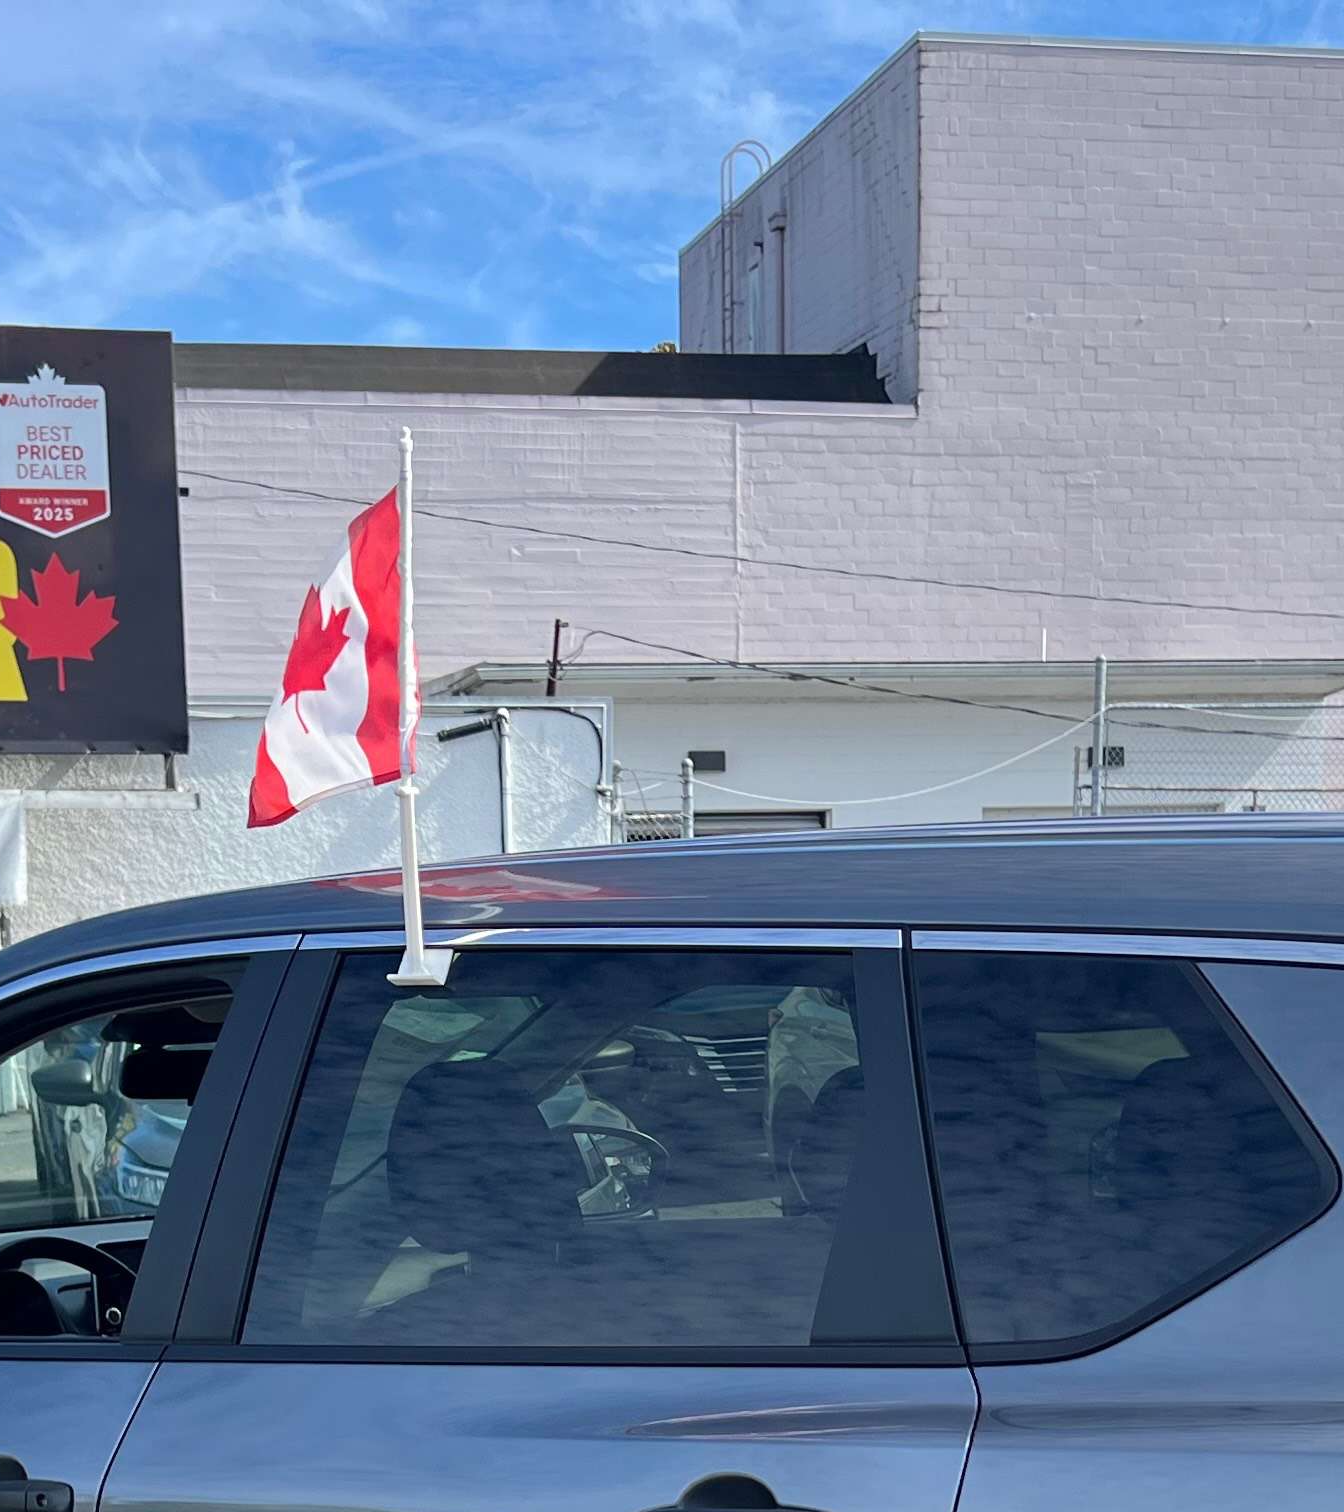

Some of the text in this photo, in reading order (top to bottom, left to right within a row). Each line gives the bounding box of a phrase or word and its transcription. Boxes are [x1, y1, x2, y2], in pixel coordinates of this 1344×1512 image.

[7, 393, 99, 410] AutoTrader
[26, 426, 73, 442] BEST
[16, 445, 84, 461] PRICED
[16, 463, 87, 480] DEALER
[19, 497, 89, 506] AWARD WINNER
[32, 507, 74, 521] 2025
